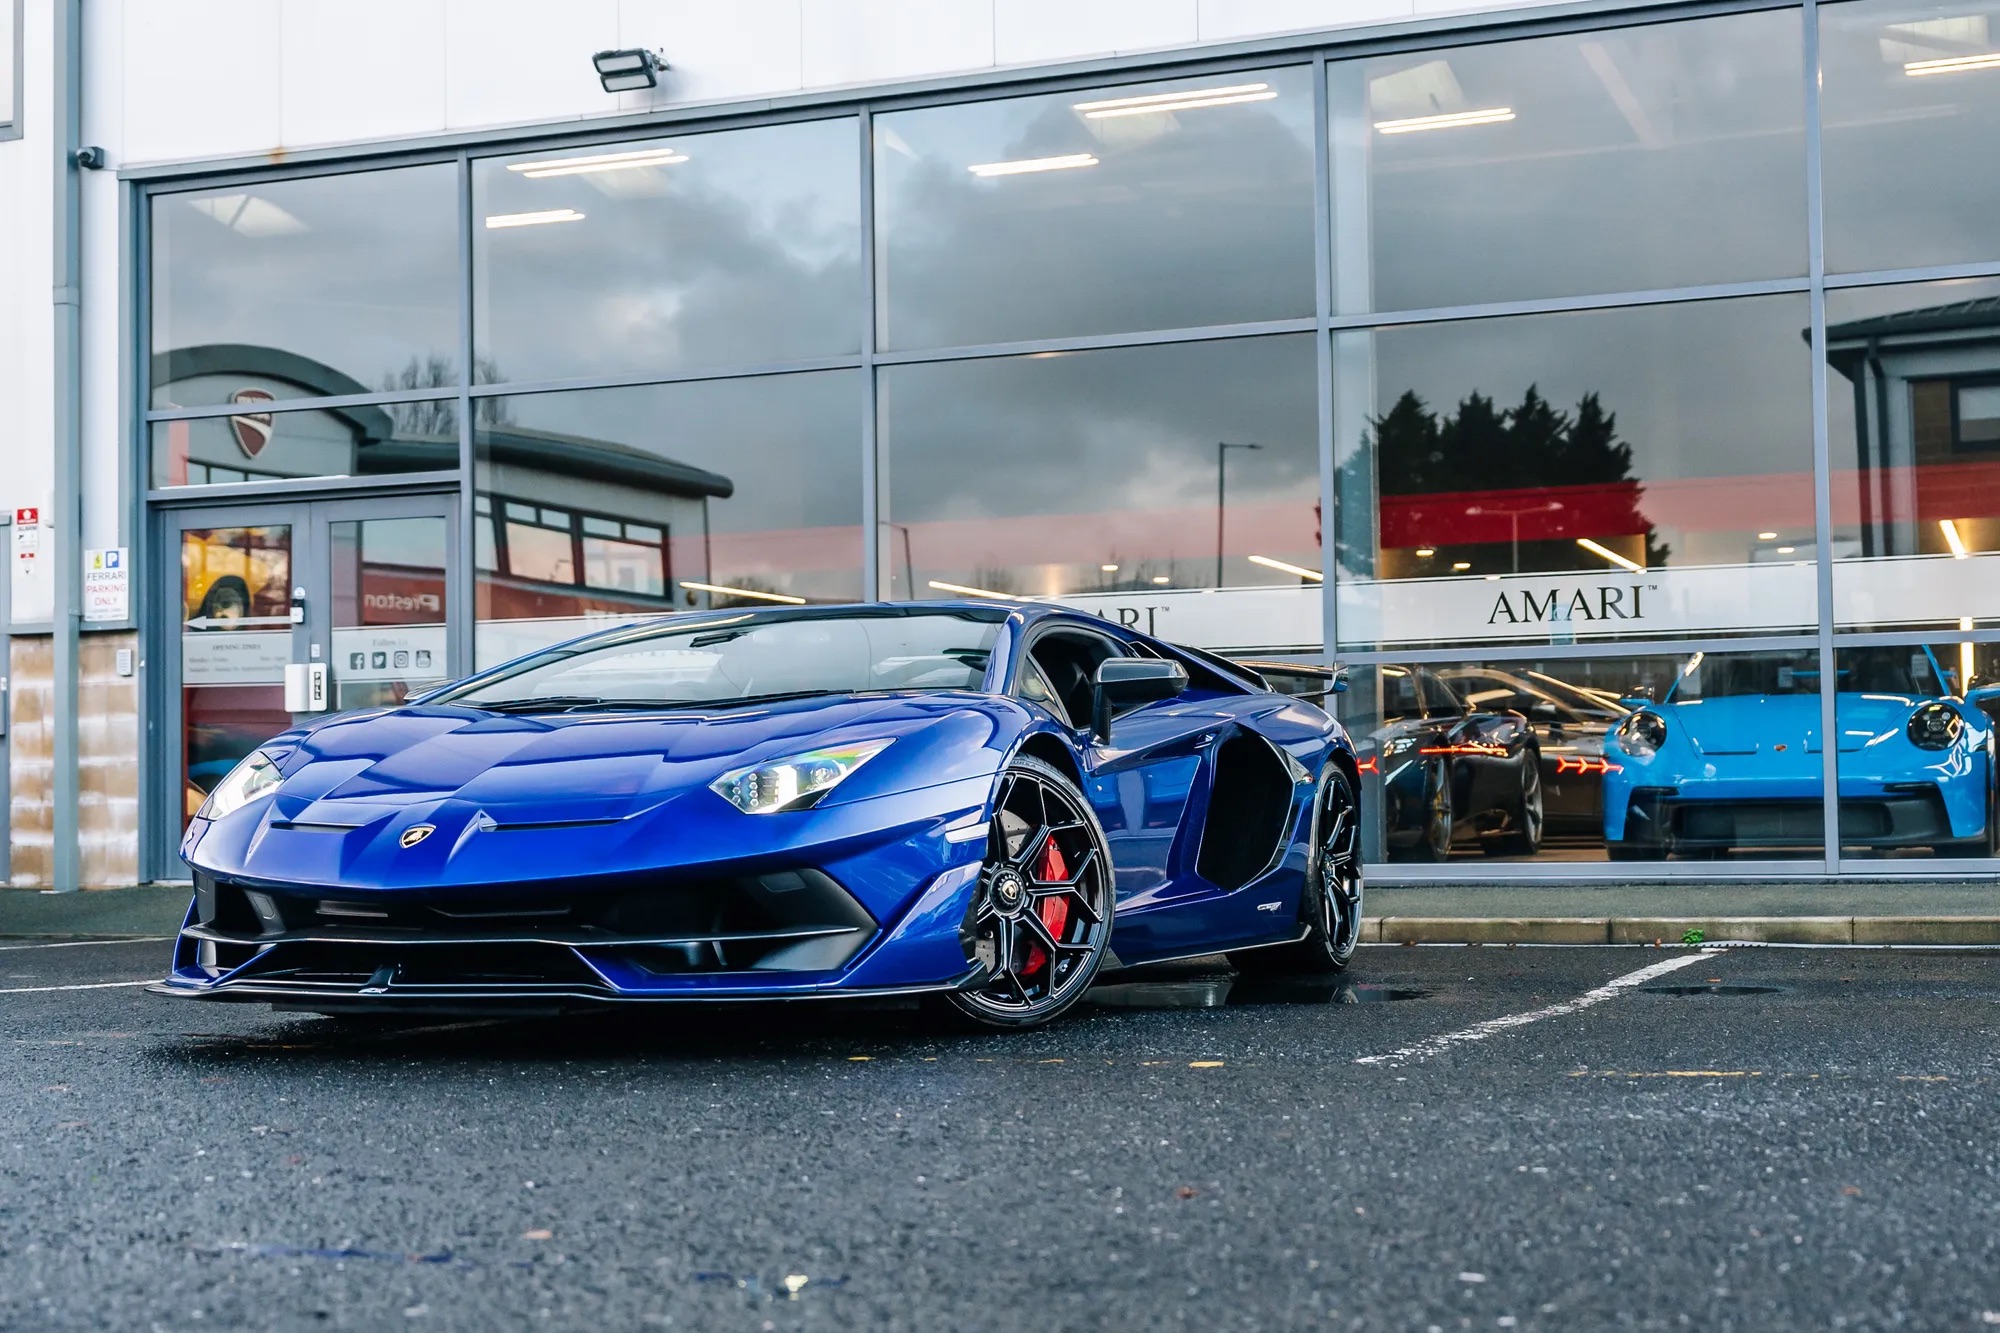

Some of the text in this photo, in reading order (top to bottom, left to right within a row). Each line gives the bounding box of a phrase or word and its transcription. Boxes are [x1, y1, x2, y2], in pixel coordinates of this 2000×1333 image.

[87, 571, 126, 581] FERRARI
[87, 584, 125, 593] PARKING
[95, 598, 117, 606] ONLY
[1487, 585, 1645, 624] AMARI
